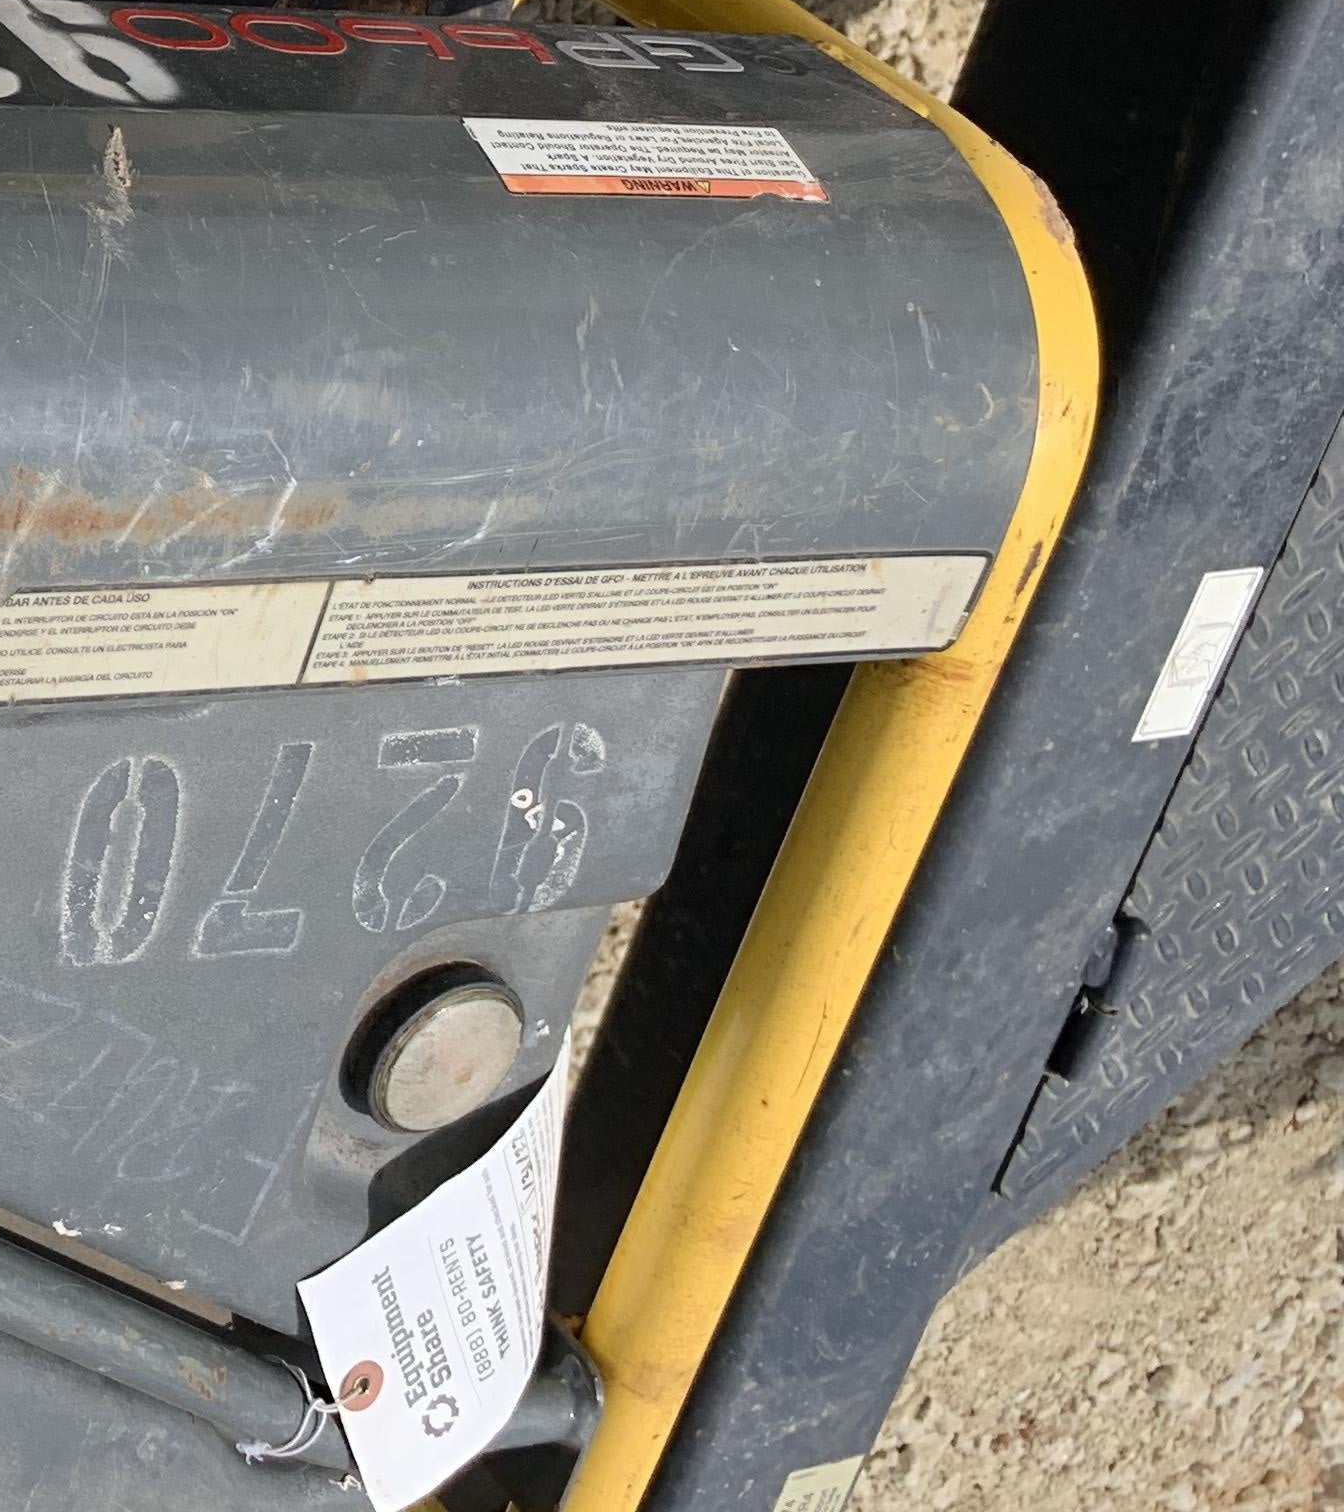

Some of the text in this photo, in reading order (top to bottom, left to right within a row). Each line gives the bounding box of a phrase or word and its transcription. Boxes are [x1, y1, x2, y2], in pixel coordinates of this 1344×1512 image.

[621, 178, 697, 193] WARNING
[31, 594, 72, 607] ANTES
[71, 594, 90, 605] DE
[90, 592, 125, 604] CADA
[124, 591, 151, 603] USO
[465, 1231, 498, 1301] SAFETY
[366, 1264, 428, 1409] Equipment
[438, 1236, 496, 1383] (888) 80-RENTS
[485, 1298, 512, 1360] THINK
[415, 1307, 452, 1389] Share
